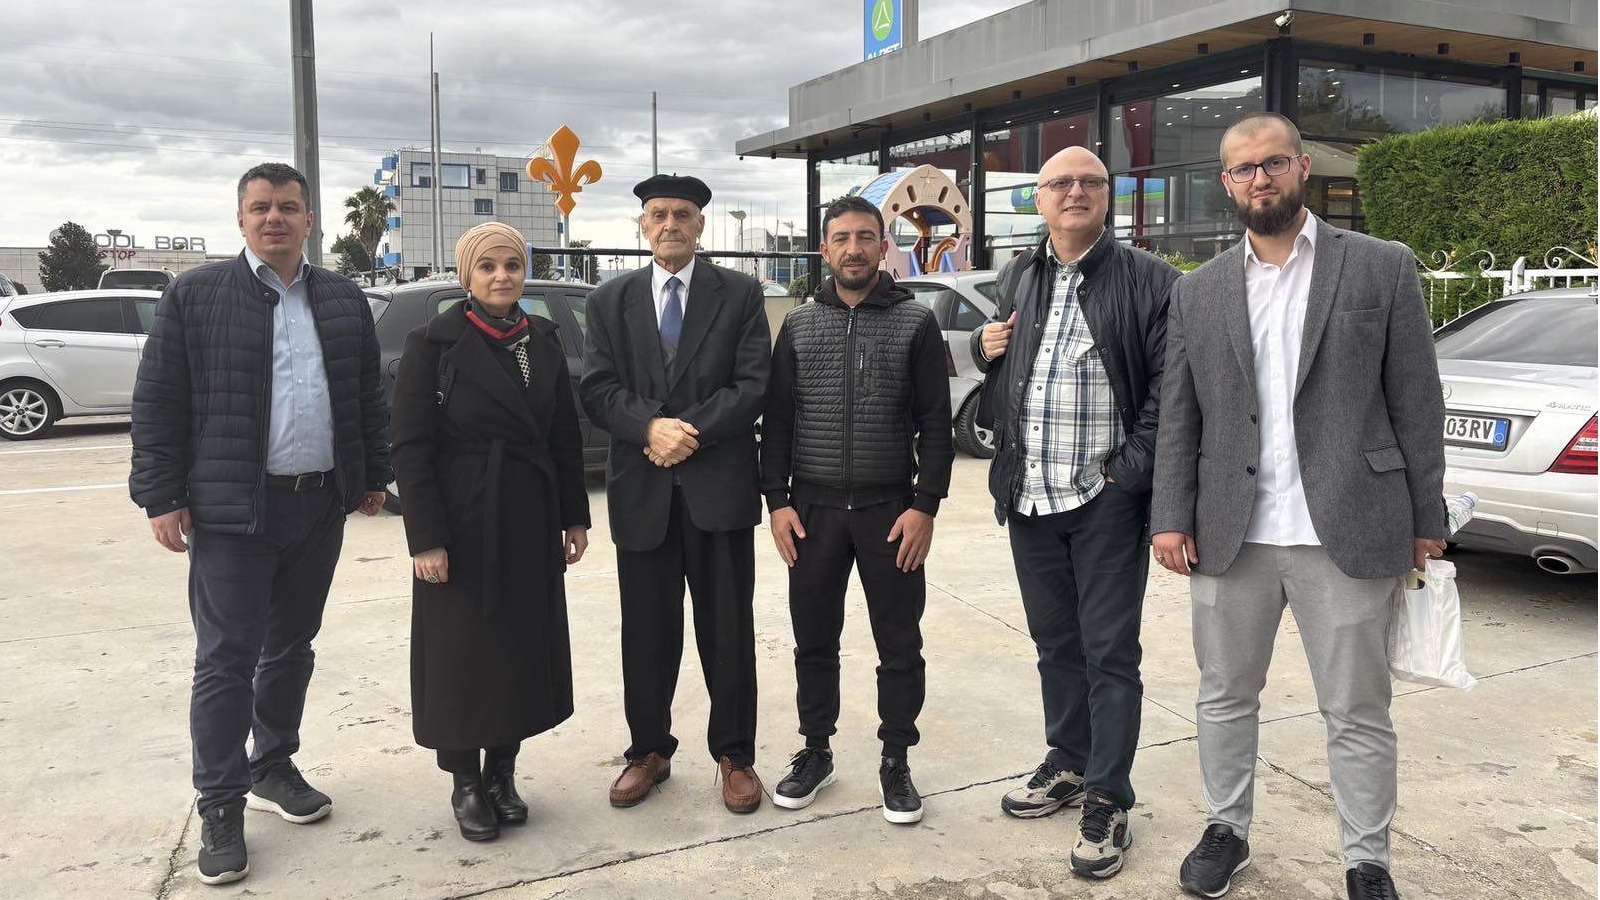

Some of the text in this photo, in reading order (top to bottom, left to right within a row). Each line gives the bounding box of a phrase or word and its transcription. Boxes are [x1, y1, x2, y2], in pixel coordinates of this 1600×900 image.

[155, 235, 206, 251] BAR
[100, 249, 136, 260] STOP
[1444, 417, 1494, 440] 03RV
